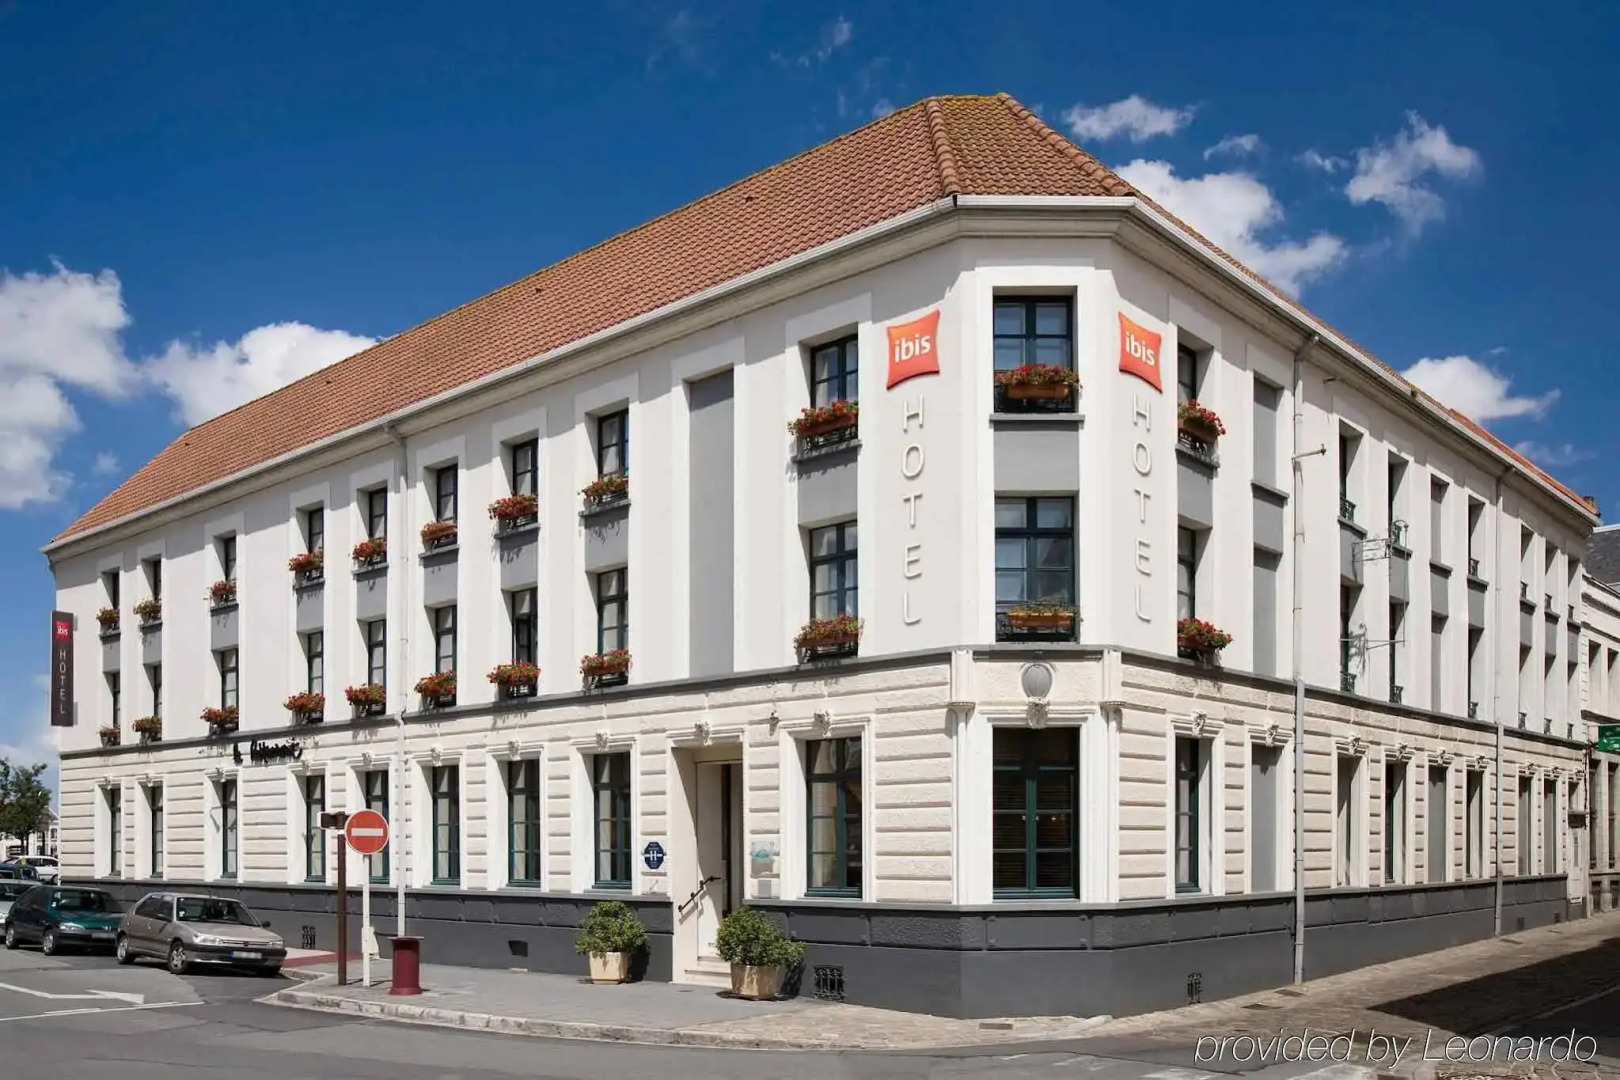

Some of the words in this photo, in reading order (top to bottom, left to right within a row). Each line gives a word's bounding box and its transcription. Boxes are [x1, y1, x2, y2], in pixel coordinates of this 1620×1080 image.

[894, 333, 931, 363] ibis
[1125, 332, 1155, 367] ibis
[902, 395, 924, 625] HOTEL
[1133, 393, 1151, 623] HOTEL
[57, 626, 69, 636] ibis
